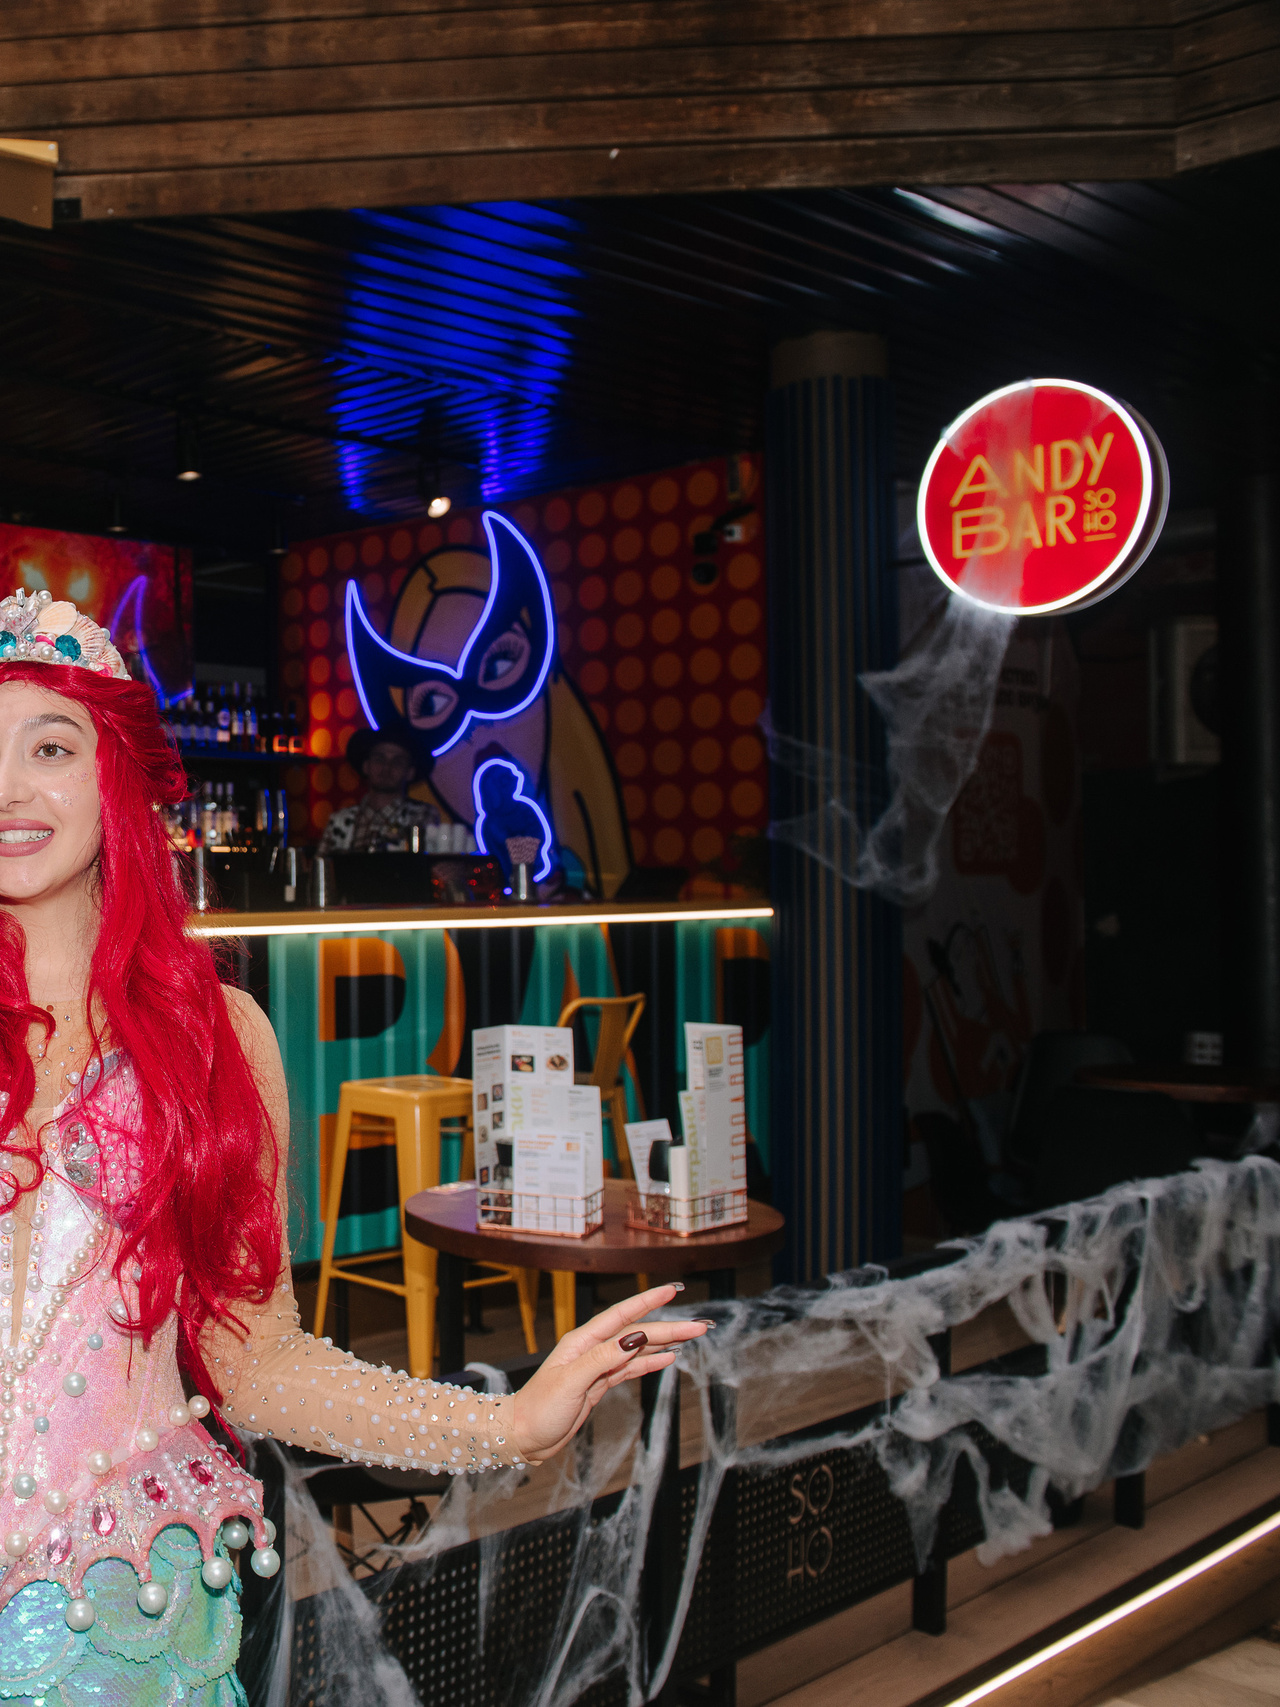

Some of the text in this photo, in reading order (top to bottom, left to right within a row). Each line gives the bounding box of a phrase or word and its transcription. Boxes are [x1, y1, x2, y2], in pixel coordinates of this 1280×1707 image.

[949, 432, 1115, 508] ANDY
[1082, 487, 1117, 511] SO
[952, 494, 1078, 559] BAR
[1083, 509, 1117, 533] HO
[788, 1464, 834, 1525] SO
[786, 1526, 834, 1588] HO
